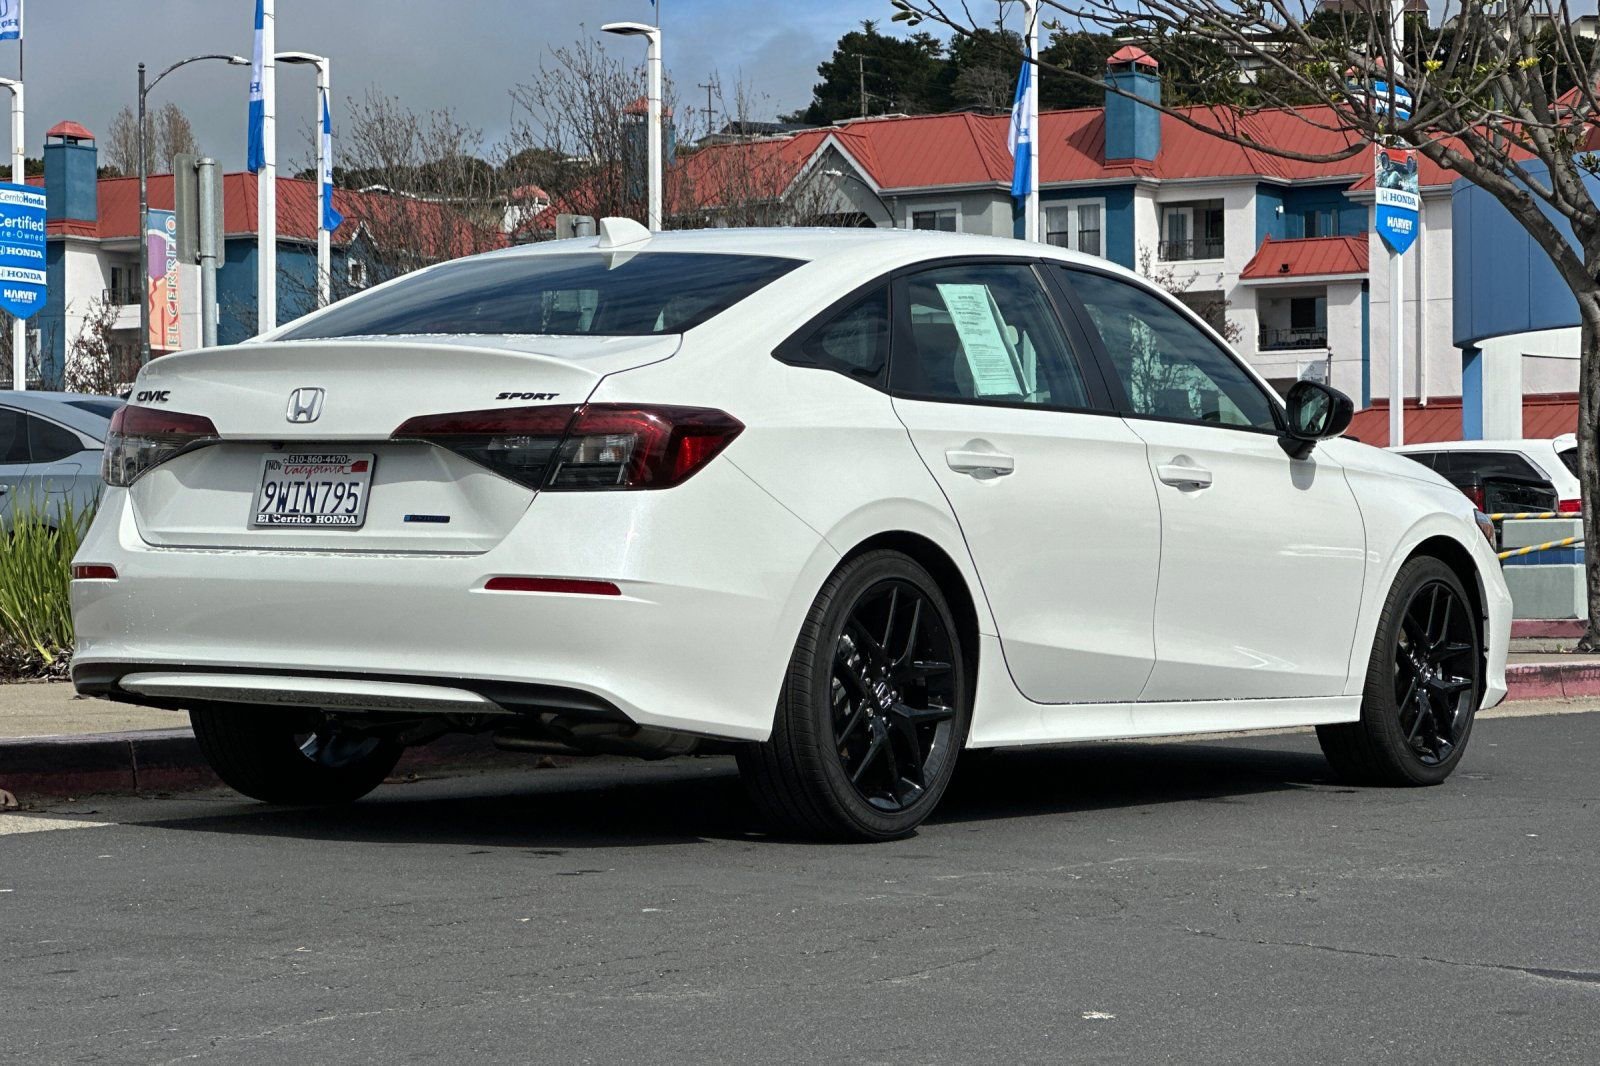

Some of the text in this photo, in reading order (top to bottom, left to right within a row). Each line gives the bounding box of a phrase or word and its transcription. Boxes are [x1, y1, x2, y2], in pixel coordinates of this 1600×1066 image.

[1390, 193, 1416, 206] HONDA
[6, 247, 43, 258] HONDA
[7, 270, 42, 280] HONDA
[165, 214, 178, 345] EL CERRITO
[4, 289, 37, 301] HARVEY
[137, 391, 170, 401] CIVIC
[495, 392, 560, 400] SPORT
[268, 461, 282, 471] NOV
[261, 481, 360, 514] 9WIN795
[257, 514, 356, 524] El Cerrito HONDA
